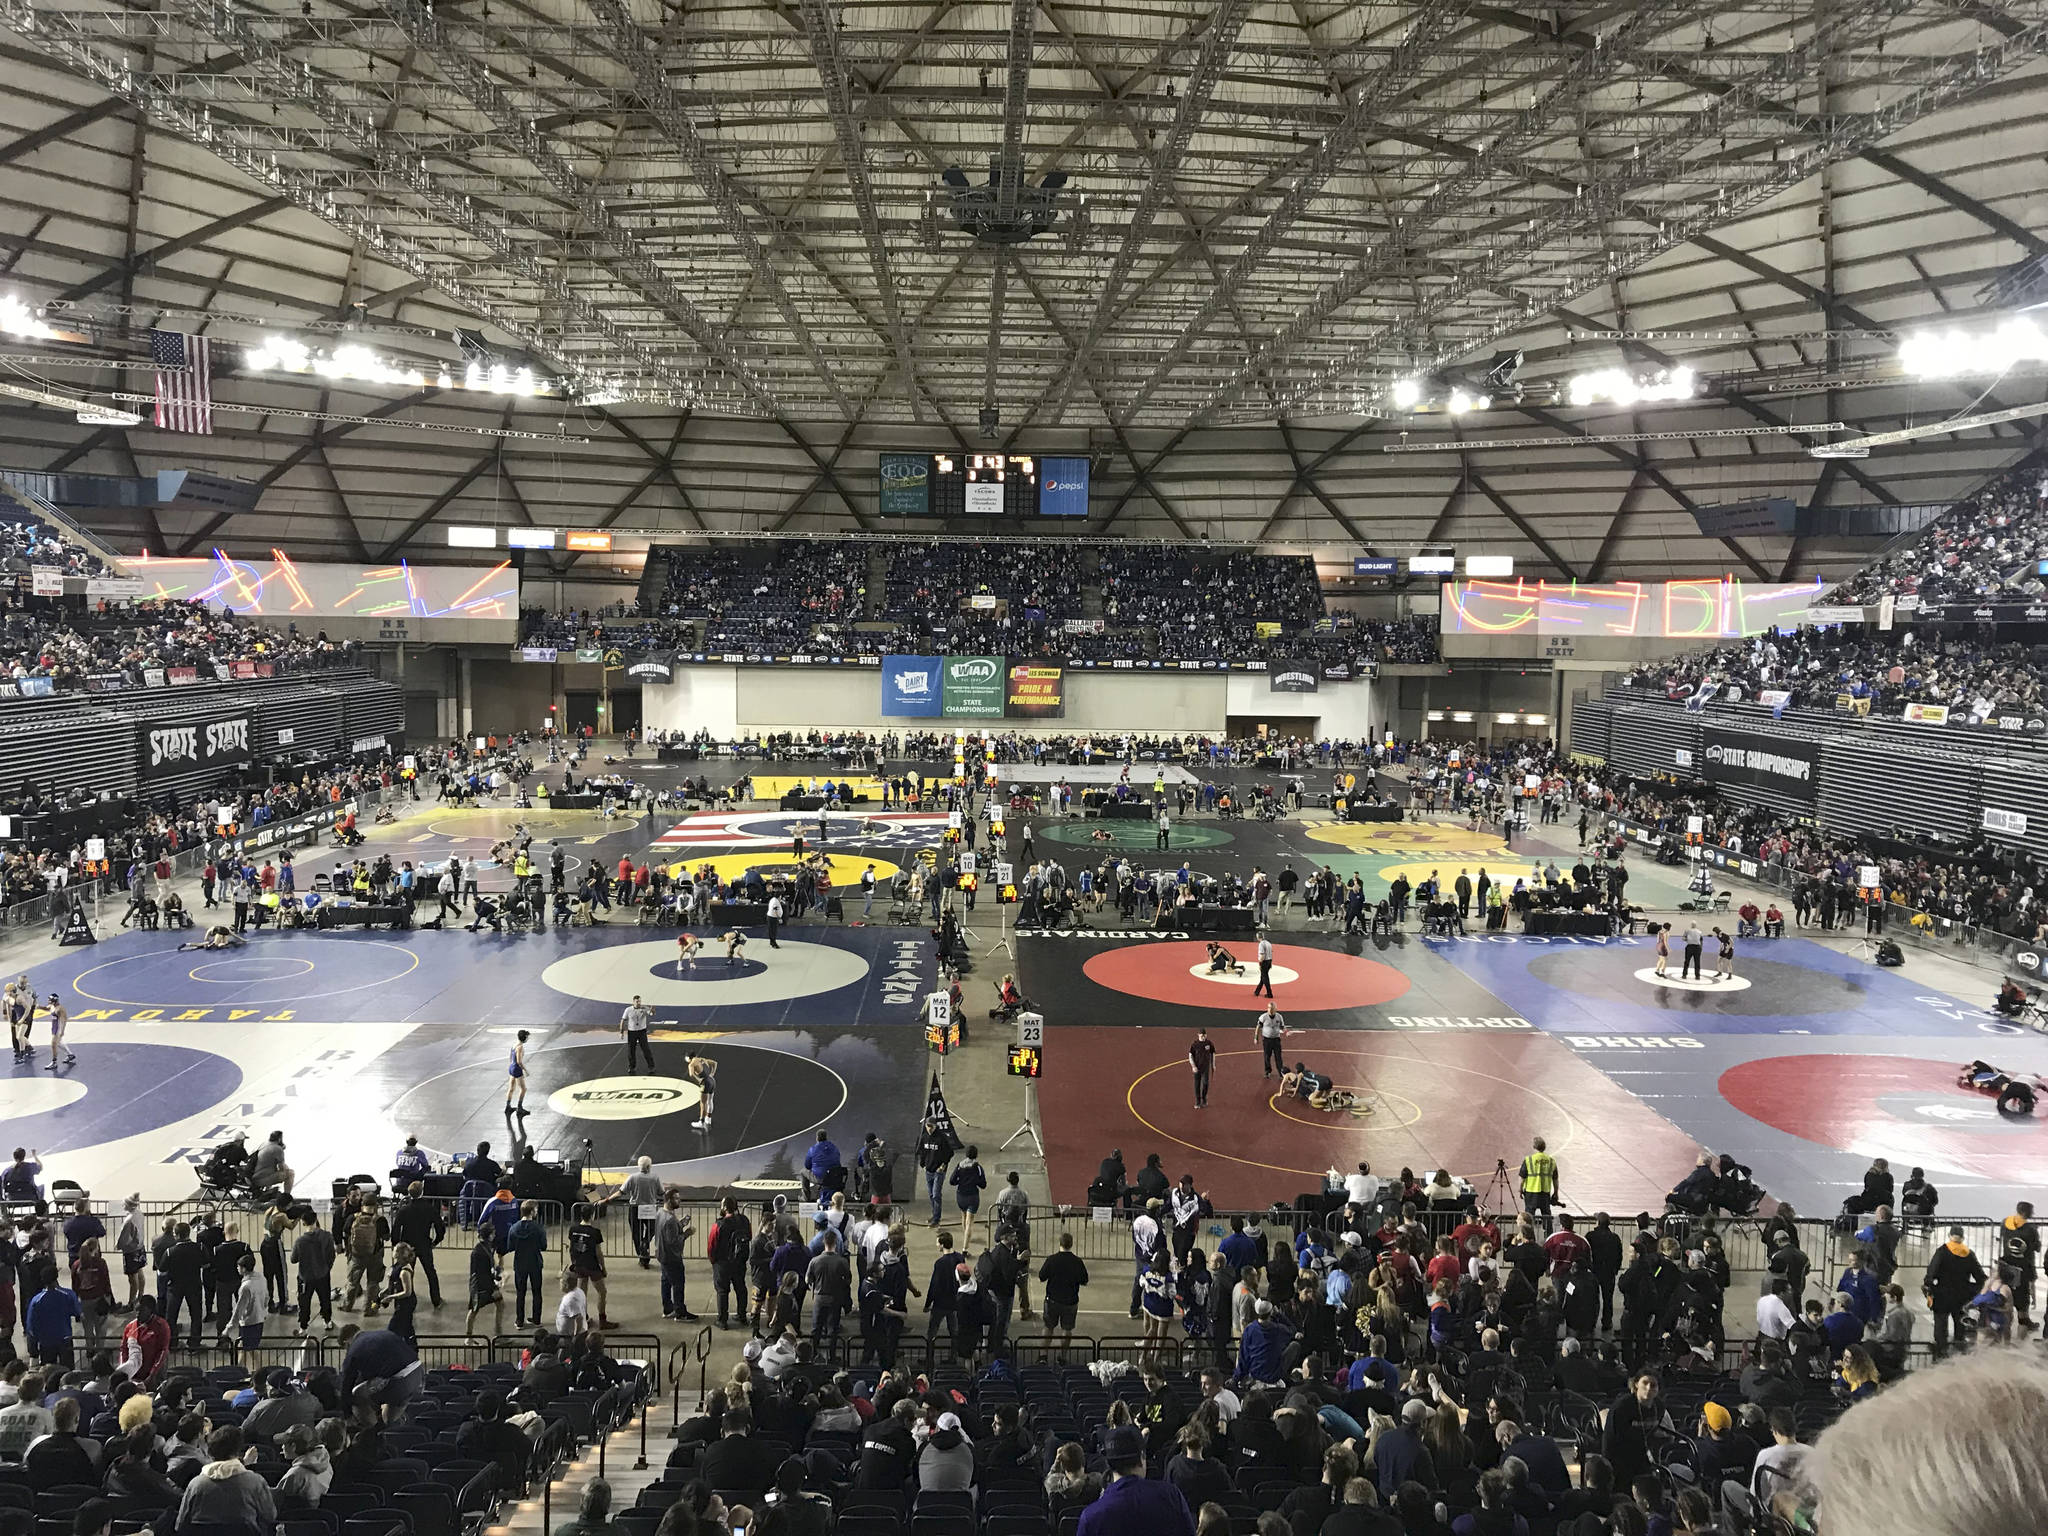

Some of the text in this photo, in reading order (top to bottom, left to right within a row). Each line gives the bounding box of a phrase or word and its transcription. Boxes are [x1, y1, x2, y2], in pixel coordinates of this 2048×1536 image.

[1058, 482, 1084, 491] pepsi
[380, 630, 408, 638] EXIT
[1546, 648, 1574, 656] EXIT
[723, 654, 744, 663] STATE
[791, 654, 812, 664] STATE
[859, 656, 879, 665] STATE
[1113, 659, 1133, 669] STATE
[628, 663, 670, 677] WRESTLING
[1180, 660, 1200, 669] STATE
[1246, 661, 1267, 670] STATE
[954, 664, 989, 677] WIAA
[905, 675, 925, 687] DAIRY
[1274, 672, 1315, 685] WRESTLING
[1018, 684, 1053, 694] PRIDE IN
[1008, 695, 1061, 705] PERFORMANCE
[945, 705, 1001, 713] CHAMPIONSHIPS
[1999, 716, 2024, 731] STATE
[150, 718, 249, 767] STATE STATE
[1723, 748, 1811, 781] STATE CHAMPIONSHIPS
[257, 829, 274, 847] STATE
[963, 861, 973, 870] 10
[1740, 859, 1758, 878] STATE
[1001, 872, 1010, 881] 21
[73, 913, 80, 925] 9
[1016, 930, 1190, 940] CARDINALS
[1425, 934, 1641, 945] FALCONS
[880, 941, 925, 1004] TITANS
[934, 1006, 947, 1019] 12
[1388, 1016, 1533, 1028] ORTING
[1023, 1028, 1040, 1040] 23
[588, 1091, 665, 1101] WIAA
[930, 1100, 945, 1118] 12
[1, 1415, 37, 1426] ROAD
